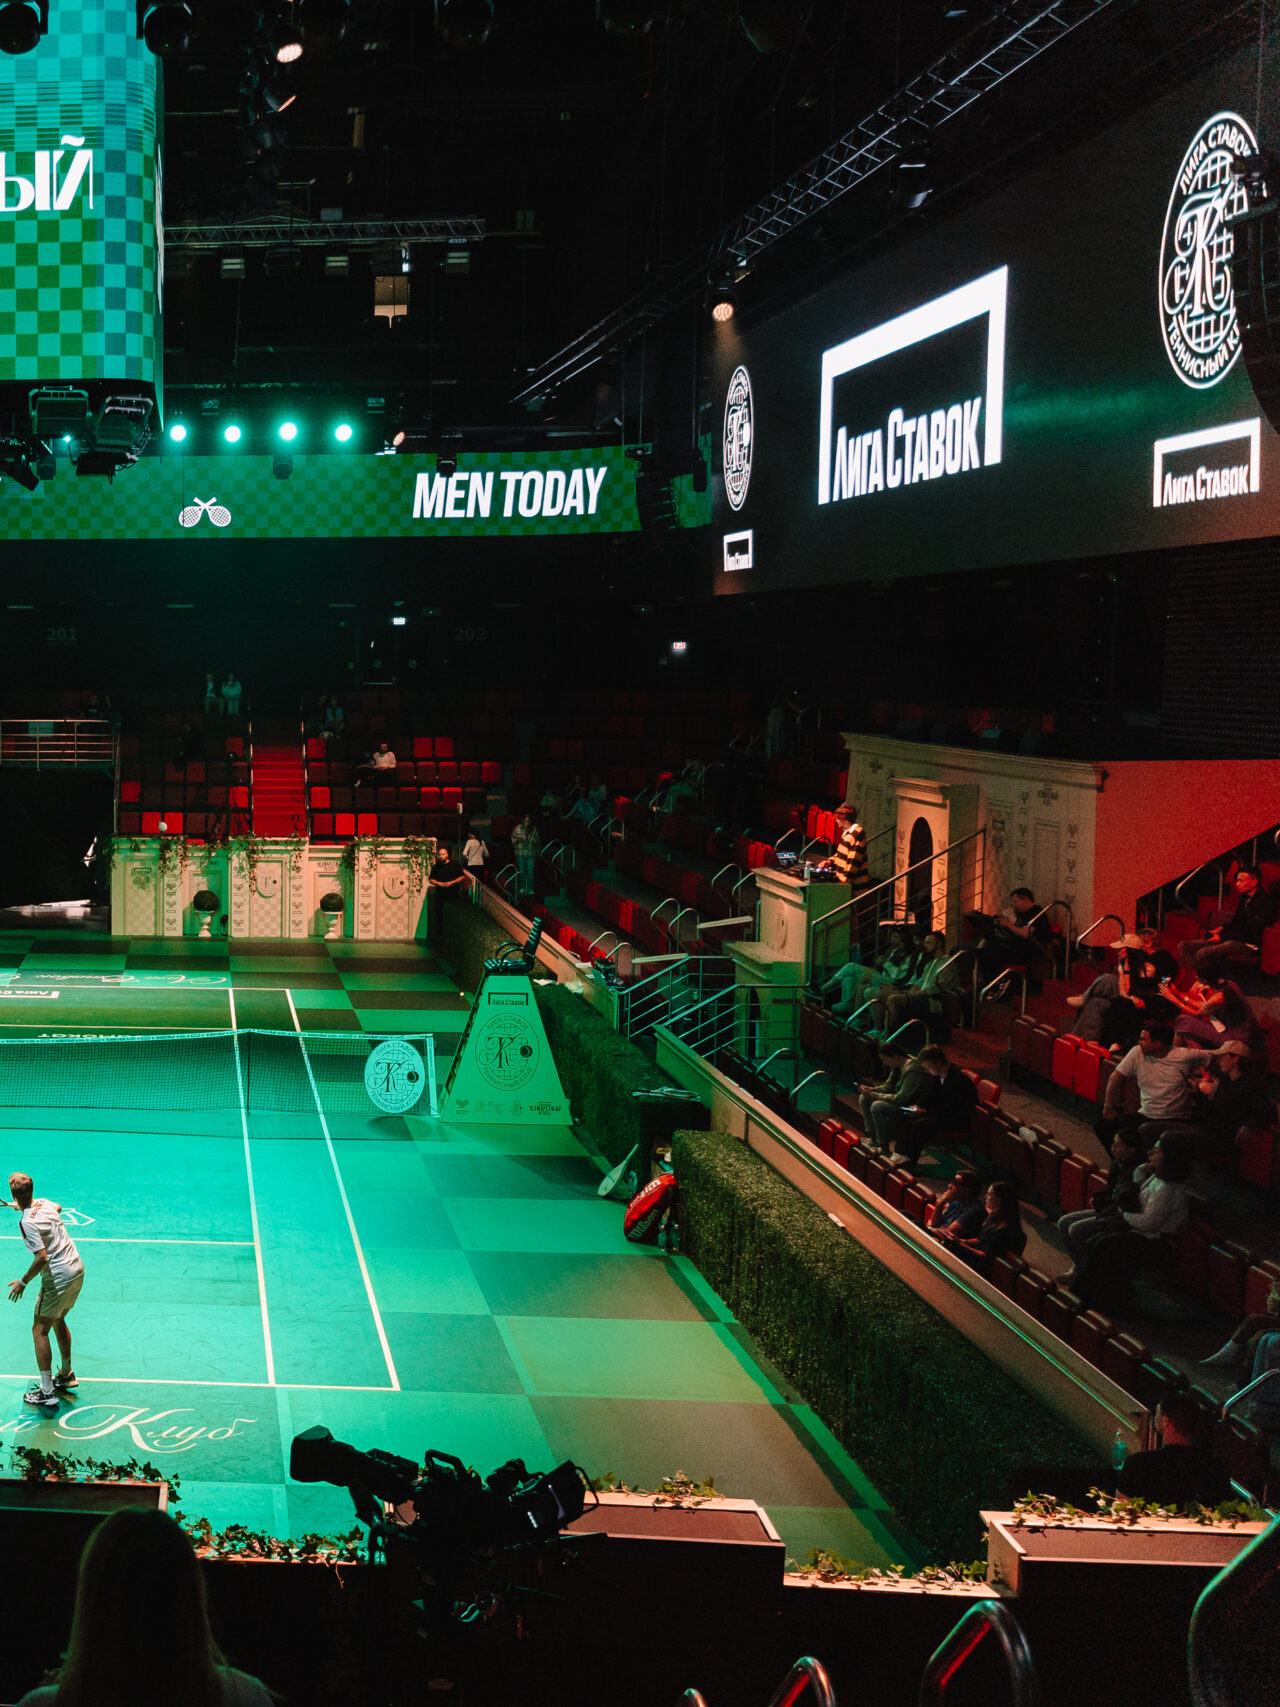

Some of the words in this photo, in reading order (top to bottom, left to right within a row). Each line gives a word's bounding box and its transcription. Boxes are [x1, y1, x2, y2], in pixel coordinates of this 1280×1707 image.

[413, 472, 494, 518] MEN
[500, 467, 608, 518] TODAY
[47, 627, 78, 641] 201
